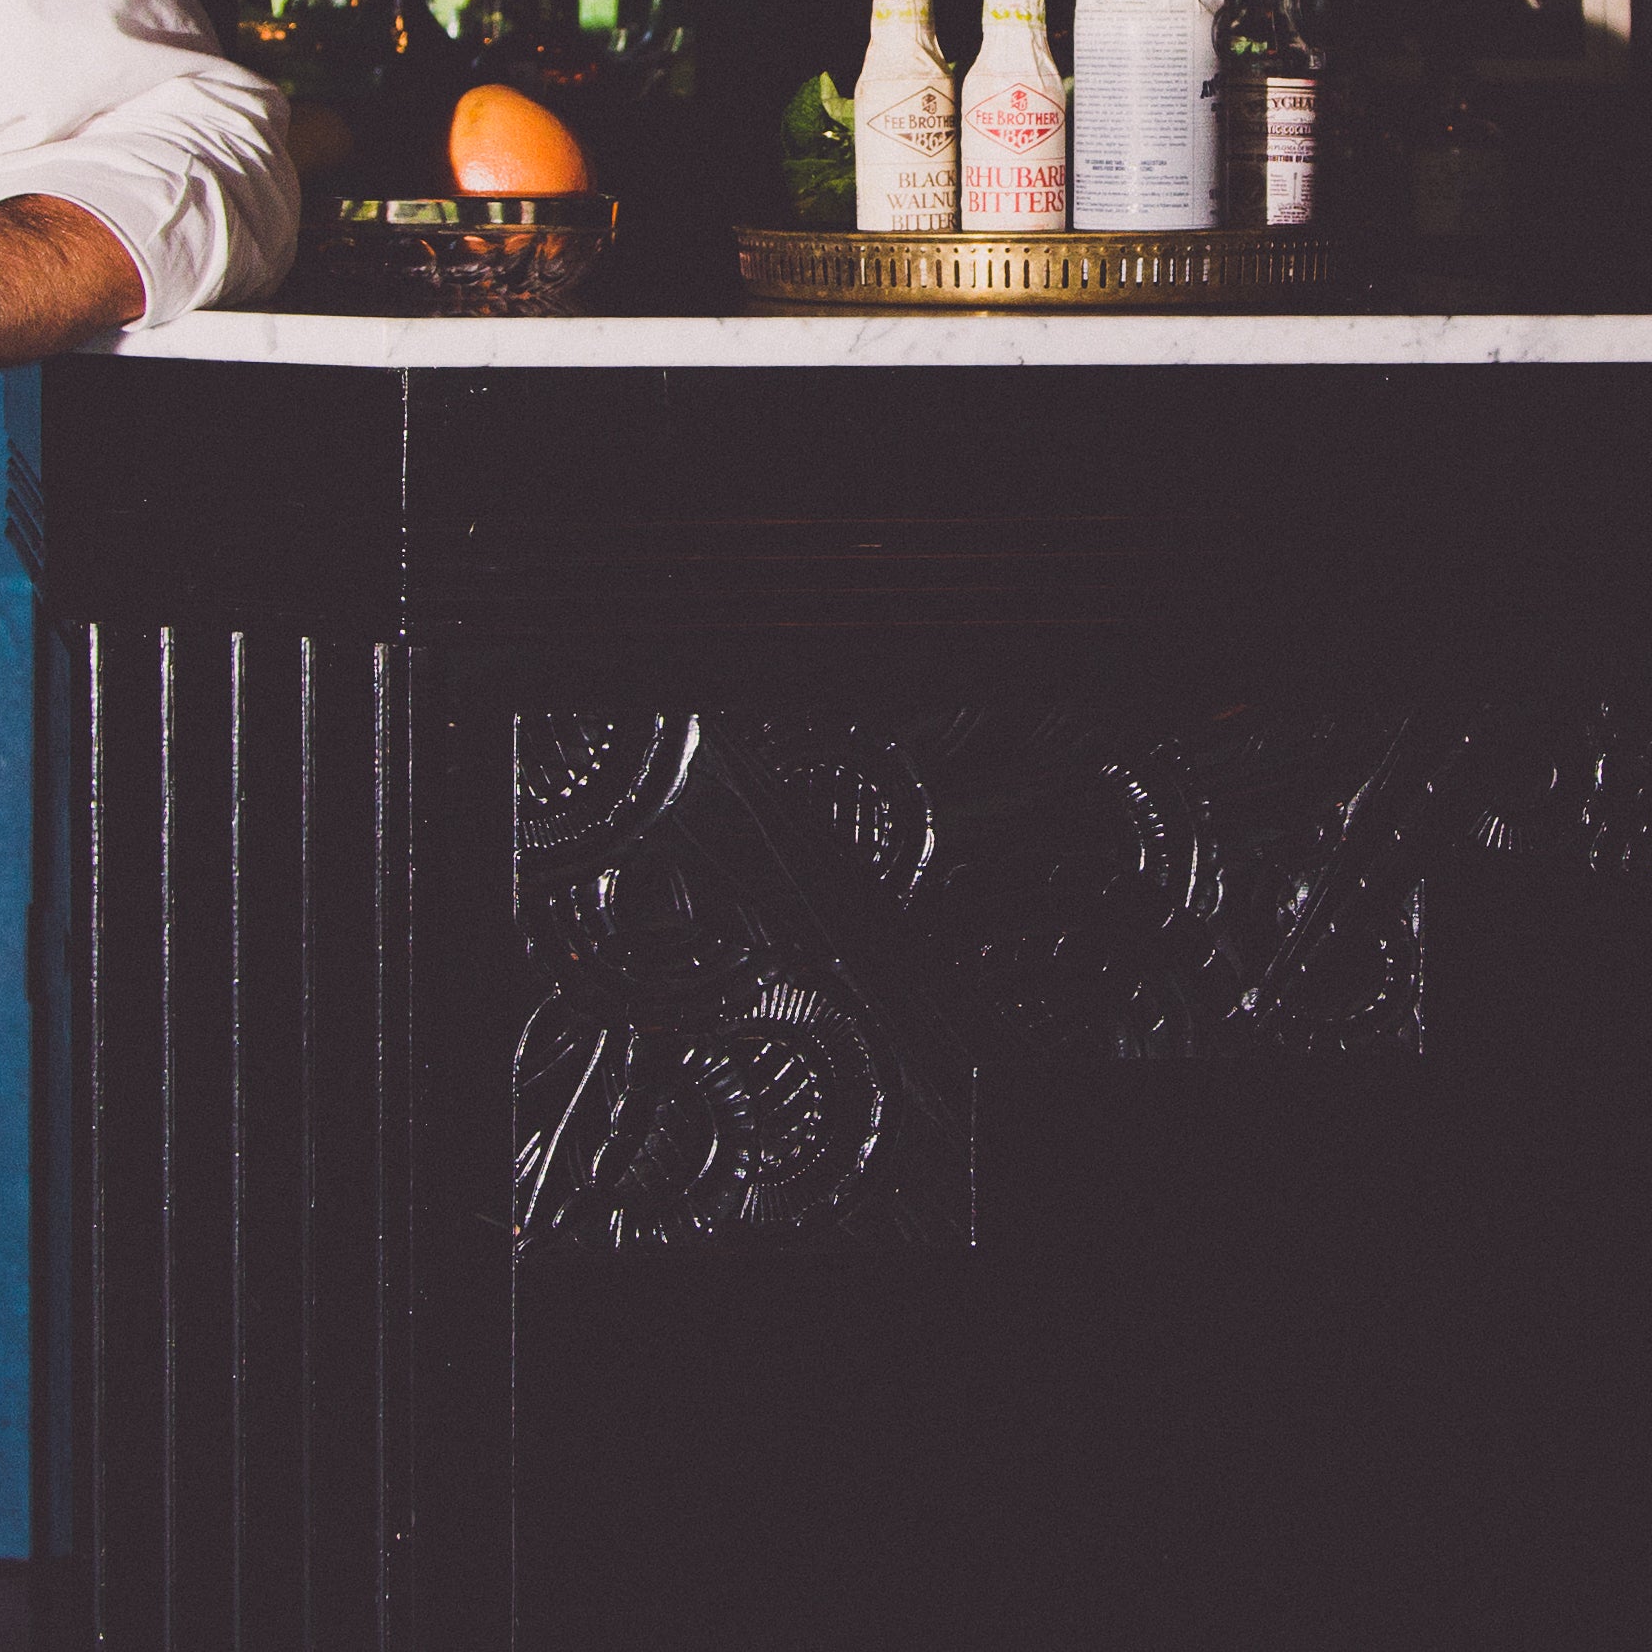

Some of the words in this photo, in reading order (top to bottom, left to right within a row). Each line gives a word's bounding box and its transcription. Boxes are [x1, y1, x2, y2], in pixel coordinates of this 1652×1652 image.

[976, 110, 993, 125] FEE
[997, 110, 1059, 126] BROTHERS
[968, 189, 1064, 213] BITTERS
